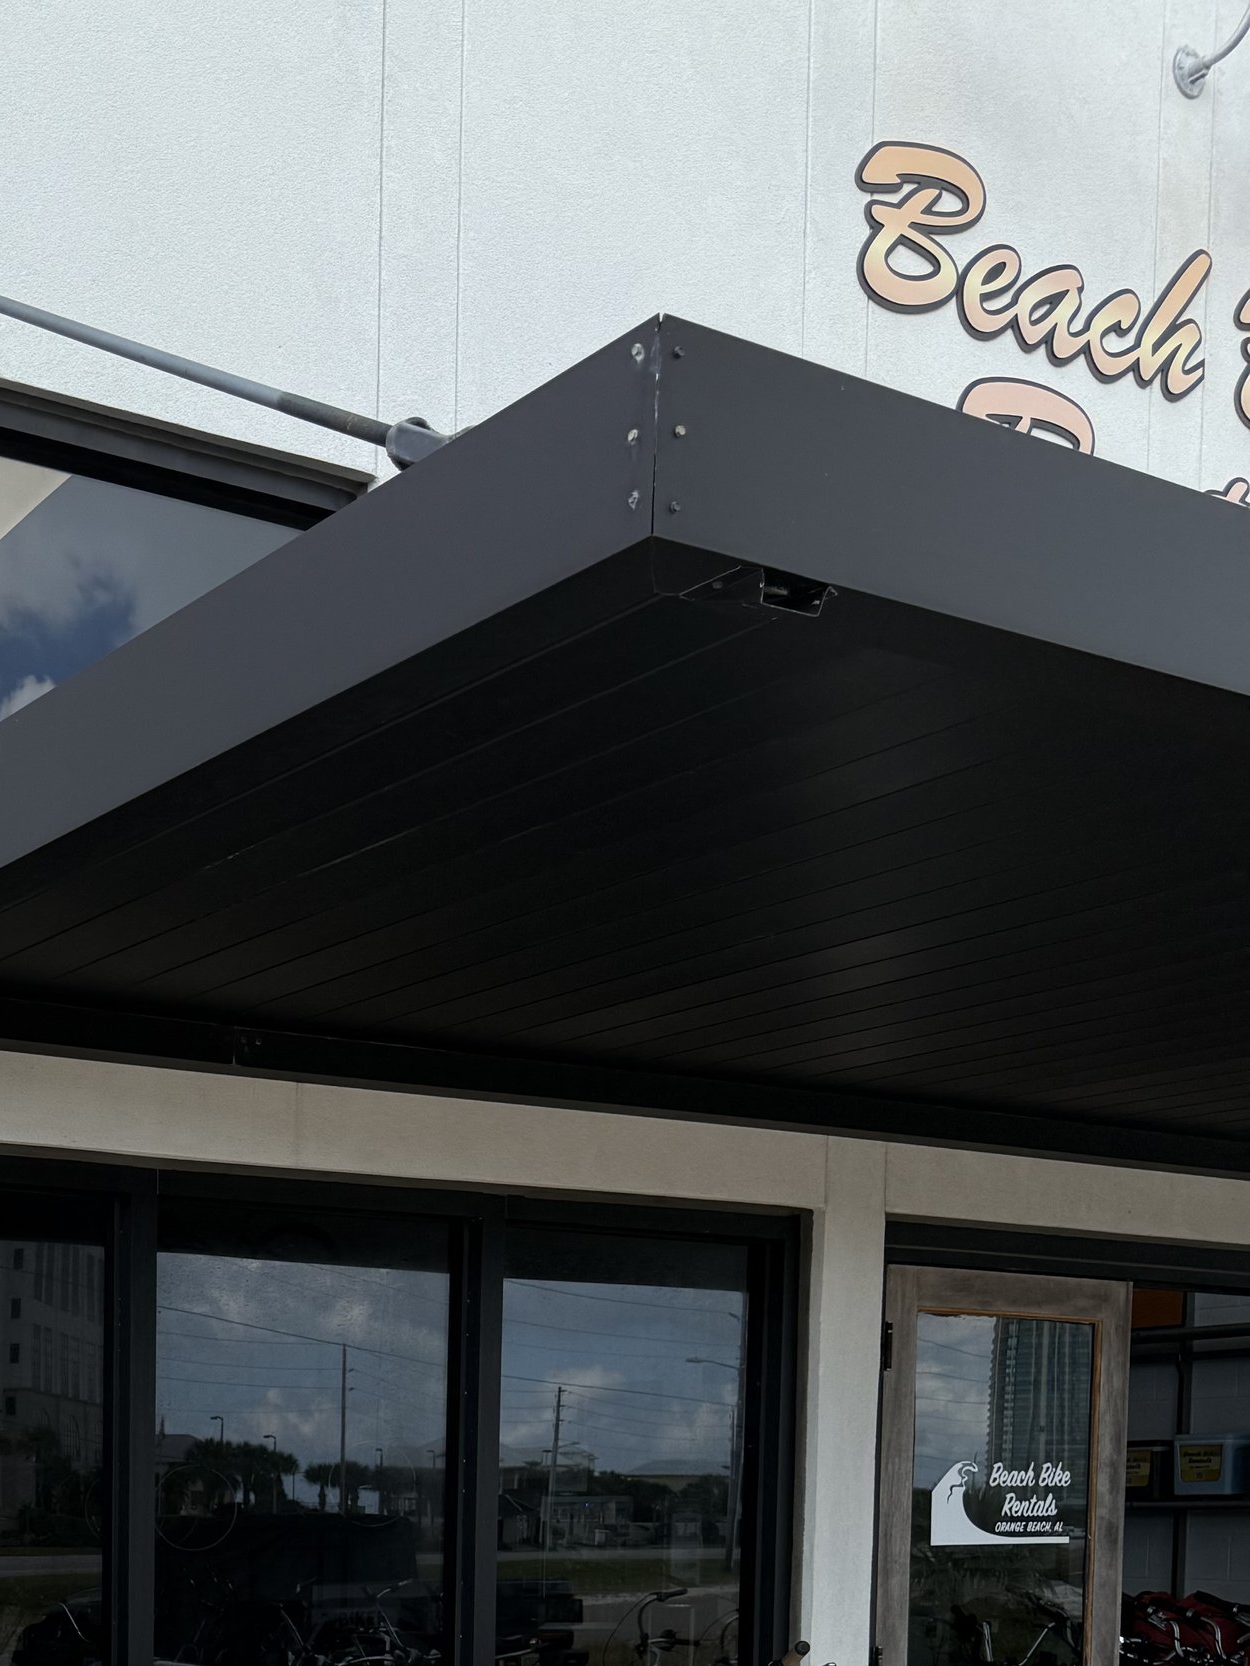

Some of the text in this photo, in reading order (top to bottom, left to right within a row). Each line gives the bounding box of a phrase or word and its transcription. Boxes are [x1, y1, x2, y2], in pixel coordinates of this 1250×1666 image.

[855, 141, 1212, 402] Beach
[989, 1461, 1071, 1487] Beach Bike
[1001, 1492, 1058, 1517] Rentals
[994, 1521, 1026, 1533] ORANGE
[1053, 1521, 1064, 1533] AL
